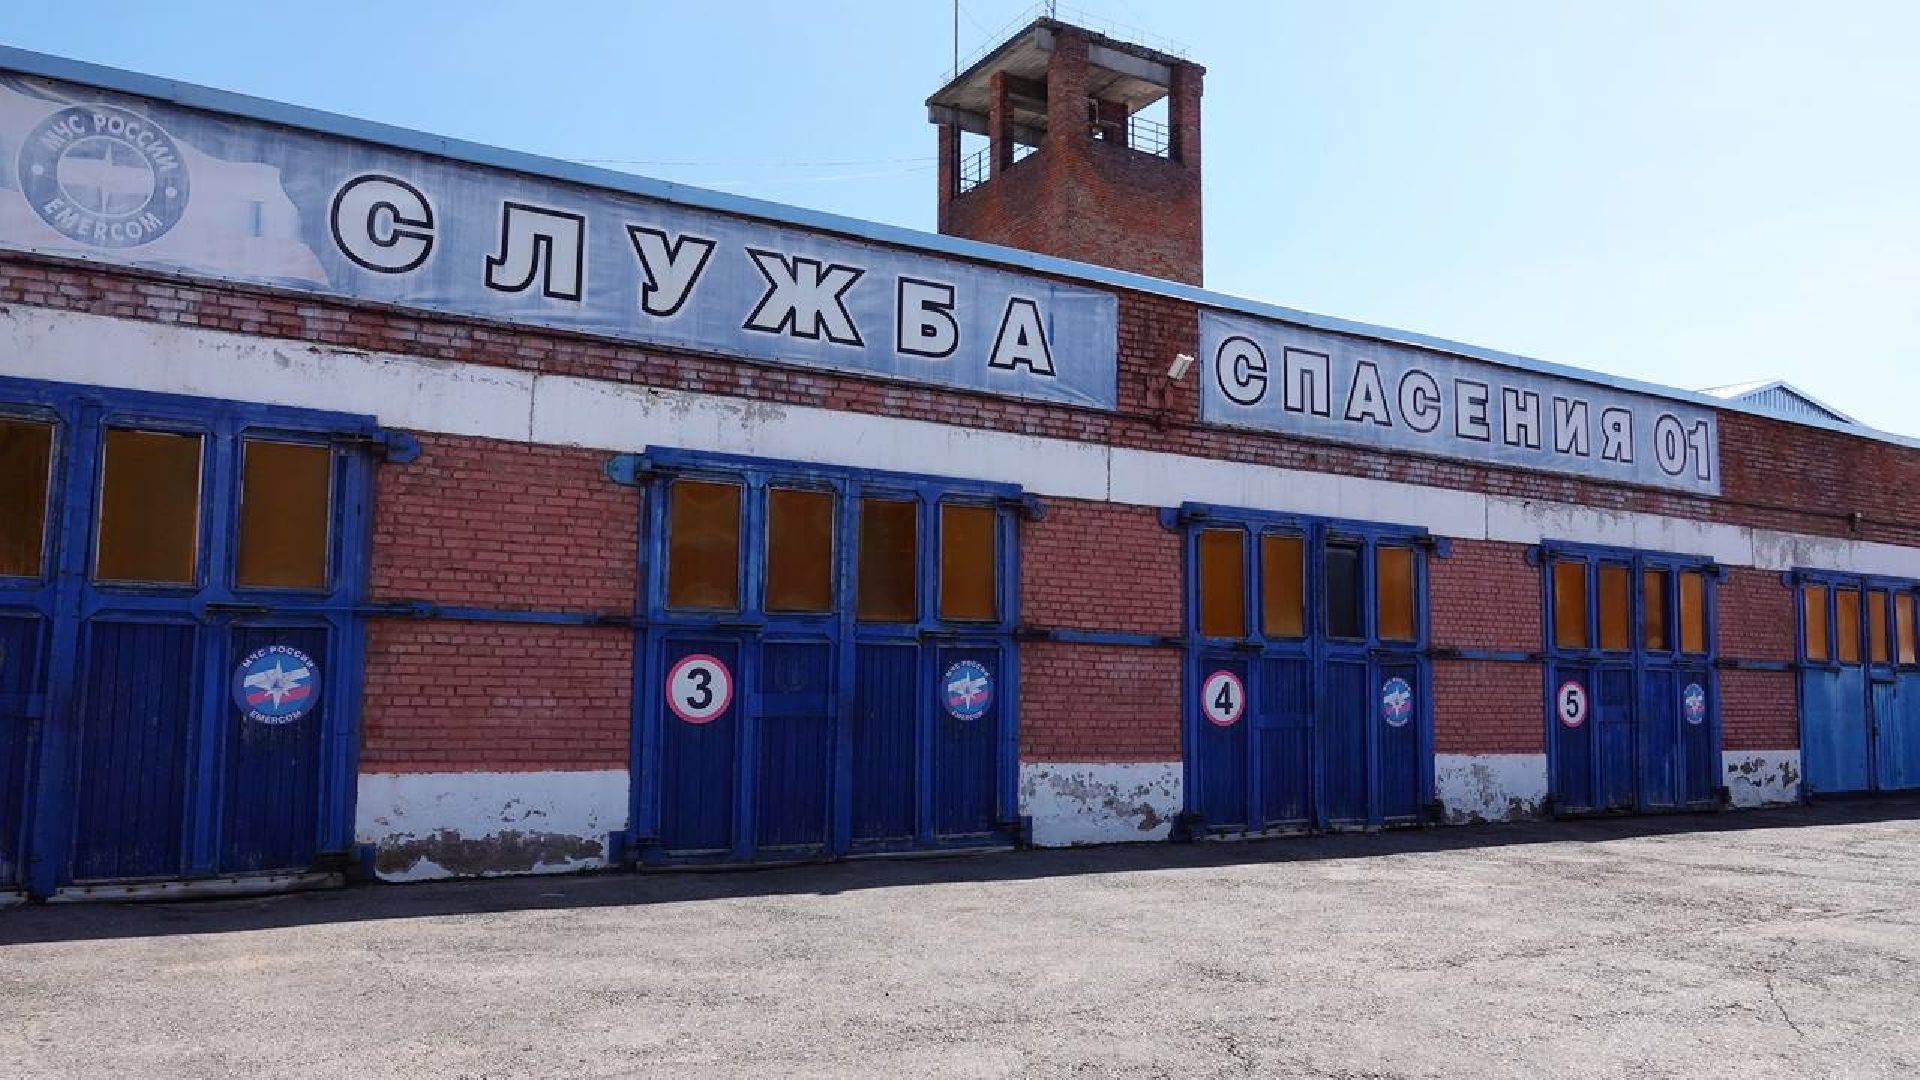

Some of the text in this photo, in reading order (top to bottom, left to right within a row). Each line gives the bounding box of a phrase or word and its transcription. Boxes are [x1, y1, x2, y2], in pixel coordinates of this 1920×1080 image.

[44, 114, 179, 173] МЧС РОССИИ
[44, 198, 164, 242] EMERCOM
[331, 175, 1056, 377] СЛУЖБА
[1216, 336, 1711, 481] СПАСЕНИЯ 01
[687, 668, 713, 709] 3
[1215, 681, 1234, 715] 4
[1566, 690, 1579, 718] 5
